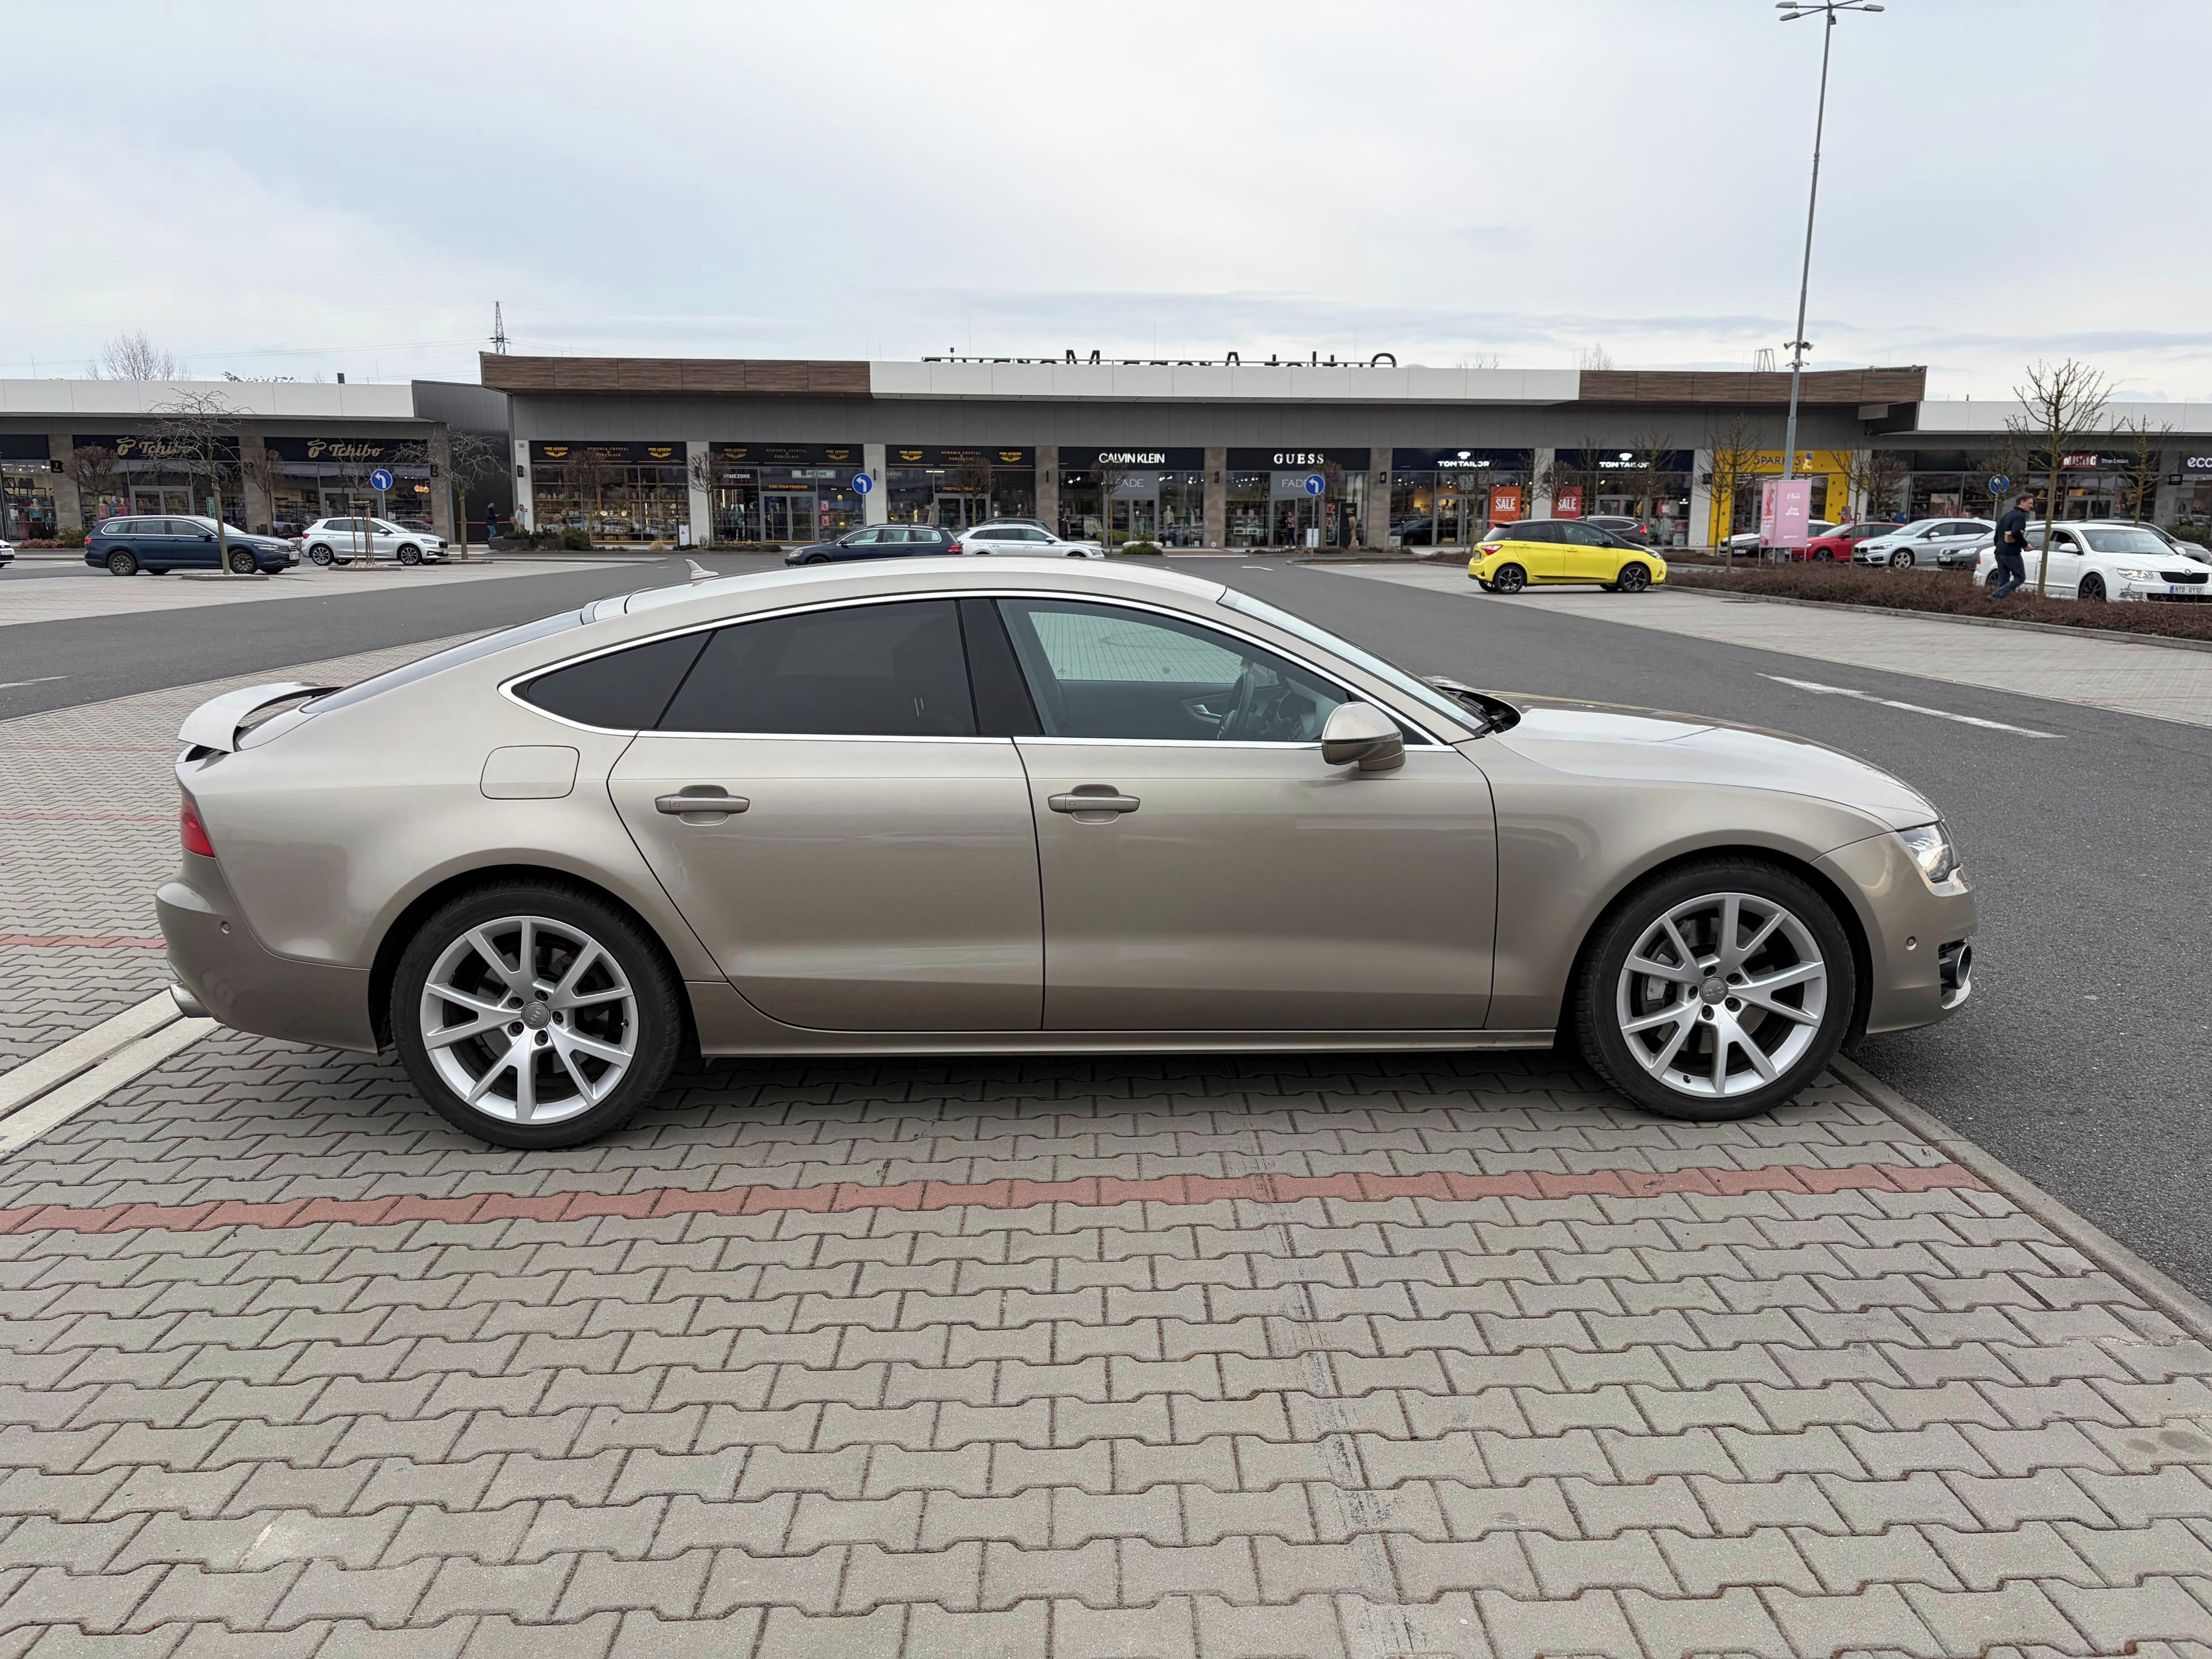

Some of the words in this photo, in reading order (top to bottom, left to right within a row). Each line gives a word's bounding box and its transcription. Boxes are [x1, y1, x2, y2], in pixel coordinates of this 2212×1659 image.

[328, 444, 385, 457] Tchibo
[1098, 453, 1135, 463] CALVIN
[1137, 454, 1165, 464] KLEIN
[1273, 454, 1324, 464] GUESS
[1753, 455, 1802, 466] SPARS
[1495, 498, 1516, 510] SALE
[1557, 498, 1577, 510] SALE
